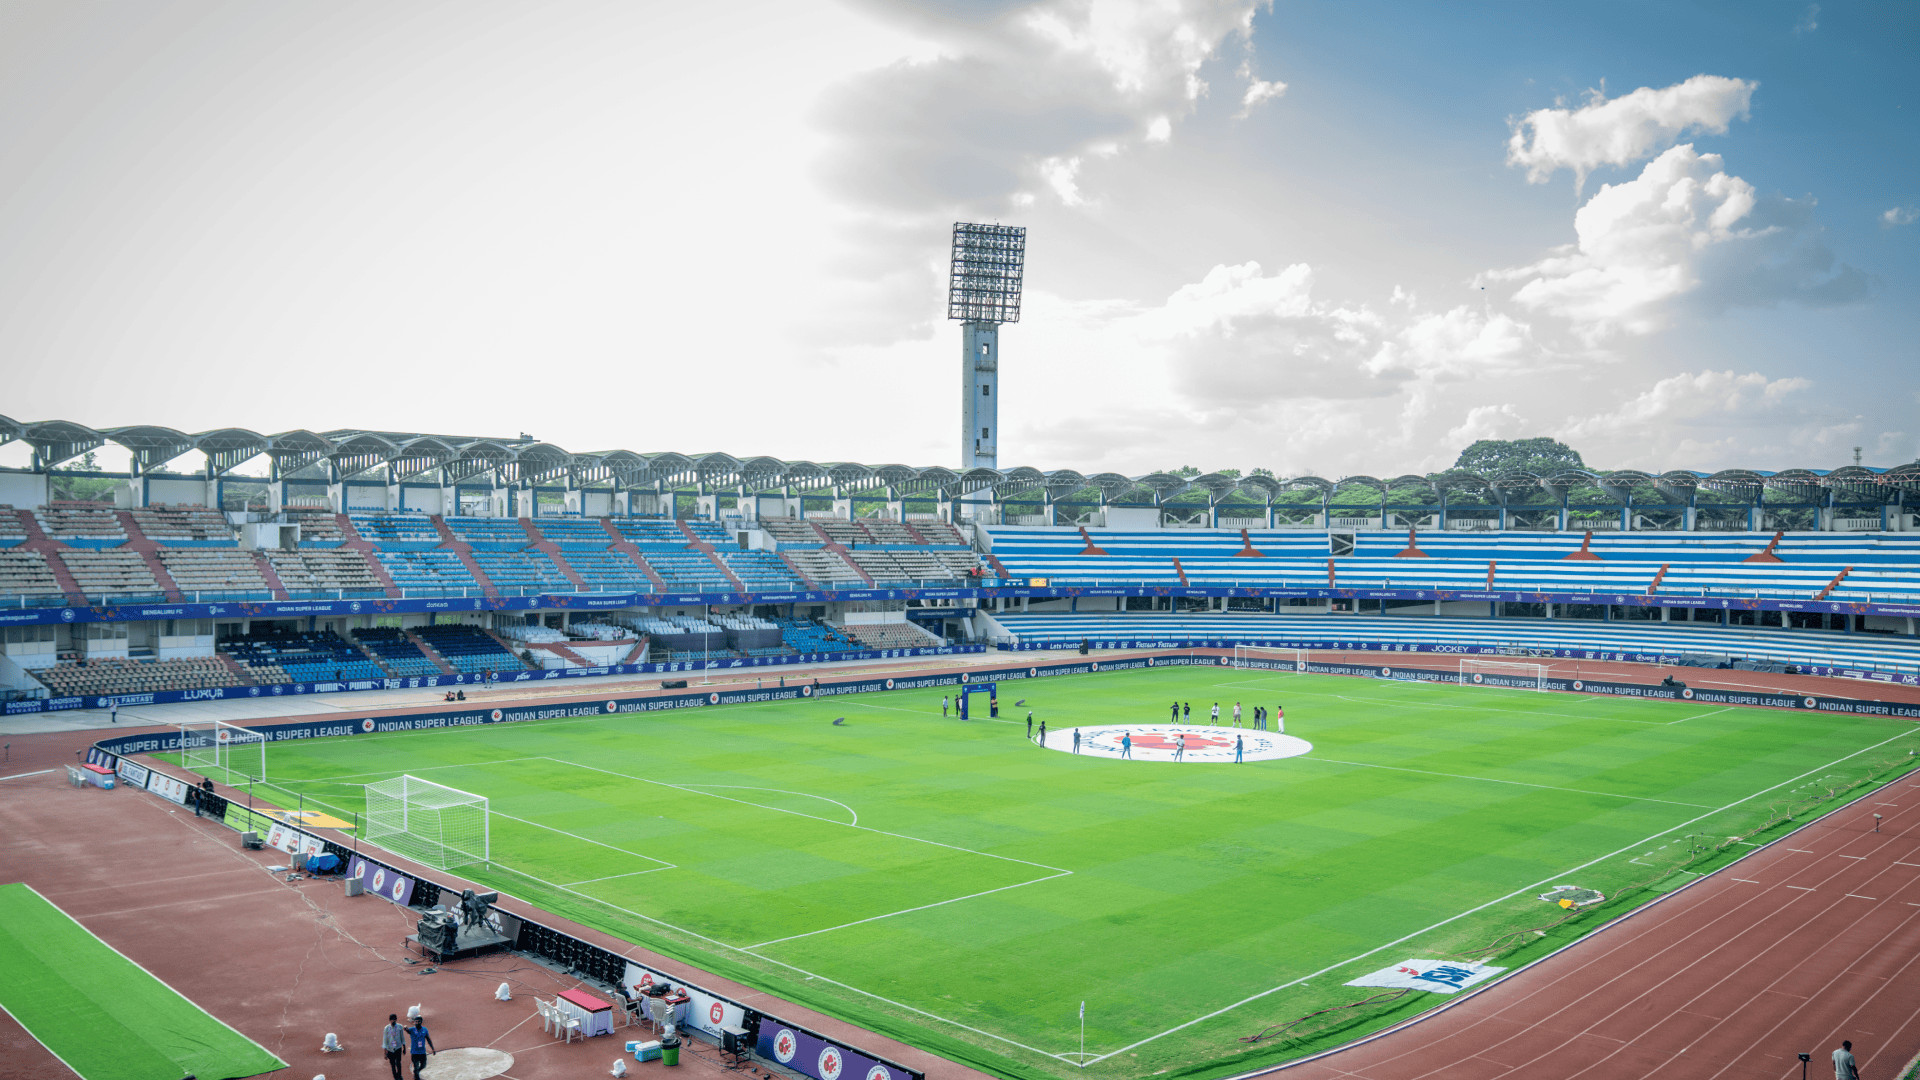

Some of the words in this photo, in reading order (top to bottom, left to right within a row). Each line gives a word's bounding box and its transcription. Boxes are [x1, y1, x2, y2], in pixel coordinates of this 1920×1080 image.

[1432, 645, 1469, 653] JOCKEY
[1190, 658, 1216, 666] LEAGUE
[1230, 660, 1249, 668] INDIAN
[1250, 661, 1269, 669] SUPER
[1271, 663, 1294, 671] LEAGUE
[1054, 668, 1070, 676] SUPER
[1071, 666, 1089, 674] LEAGUE
[1307, 665, 1329, 673] INDIAN
[1330, 667, 1351, 675] SUPER
[1352, 668, 1377, 677] LEAGUE
[1392, 671, 1415, 680] INDIAN
[1416, 673, 1439, 681] SUPER
[1441, 674, 1468, 683] LEAGUE
[895, 681, 915, 690] INDIAN
[917, 680, 935, 688] SUPER
[936, 677, 957, 686] LEAGUE
[970, 676, 988, 684] INDIAN
[989, 674, 1005, 682] SUPER
[1006, 672, 1026, 680] LEAGUE
[1484, 677, 1509, 686] INDIAN
[1511, 679, 1536, 688] SUPER
[1539, 681, 1567, 691] LEAGUE
[315, 683, 339, 693] PUMA
[349, 681, 372, 690] PUMA
[836, 686, 856, 695] SUPER
[858, 684, 881, 693] LEAGUE
[1585, 685, 1613, 694] INDIAN
[1614, 687, 1641, 696] SUPER
[1643, 689, 1675, 698] LEAGUE
[49, 697, 82, 705] RADISSON
[721, 695, 746, 705] INDIAN
[747, 693, 770, 702] SUPER
[772, 691, 797, 700] LEAGUE
[1696, 692, 1726, 703] INDIAN
[1728, 695, 1758, 705] SUPER
[1760, 697, 1796, 708] LEAGUE
[6, 701, 41, 709] RADISSON
[619, 703, 647, 713] INDIAN
[649, 701, 674, 711] SUPER
[675, 698, 704, 709] LEAGUE
[1819, 702, 1853, 712] INDIAN
[1855, 704, 1889, 715] SUPER
[1891, 706, 1920, 718] LEAG
[505, 711, 536, 722] INDIAN
[538, 709, 566, 720] SUPER
[568, 706, 600, 717] LEAGUE
[378, 721, 412, 732] INDIAN
[414, 718, 446, 729] SUPER
[448, 715, 484, 727] LEAGUE
[235, 731, 273, 744] INDIAN
[276, 729, 311, 741] SUPER
[314, 726, 353, 737] LEAGUE
[123, 740, 159, 754] SUPER
[163, 736, 207, 750] LEAGUE
